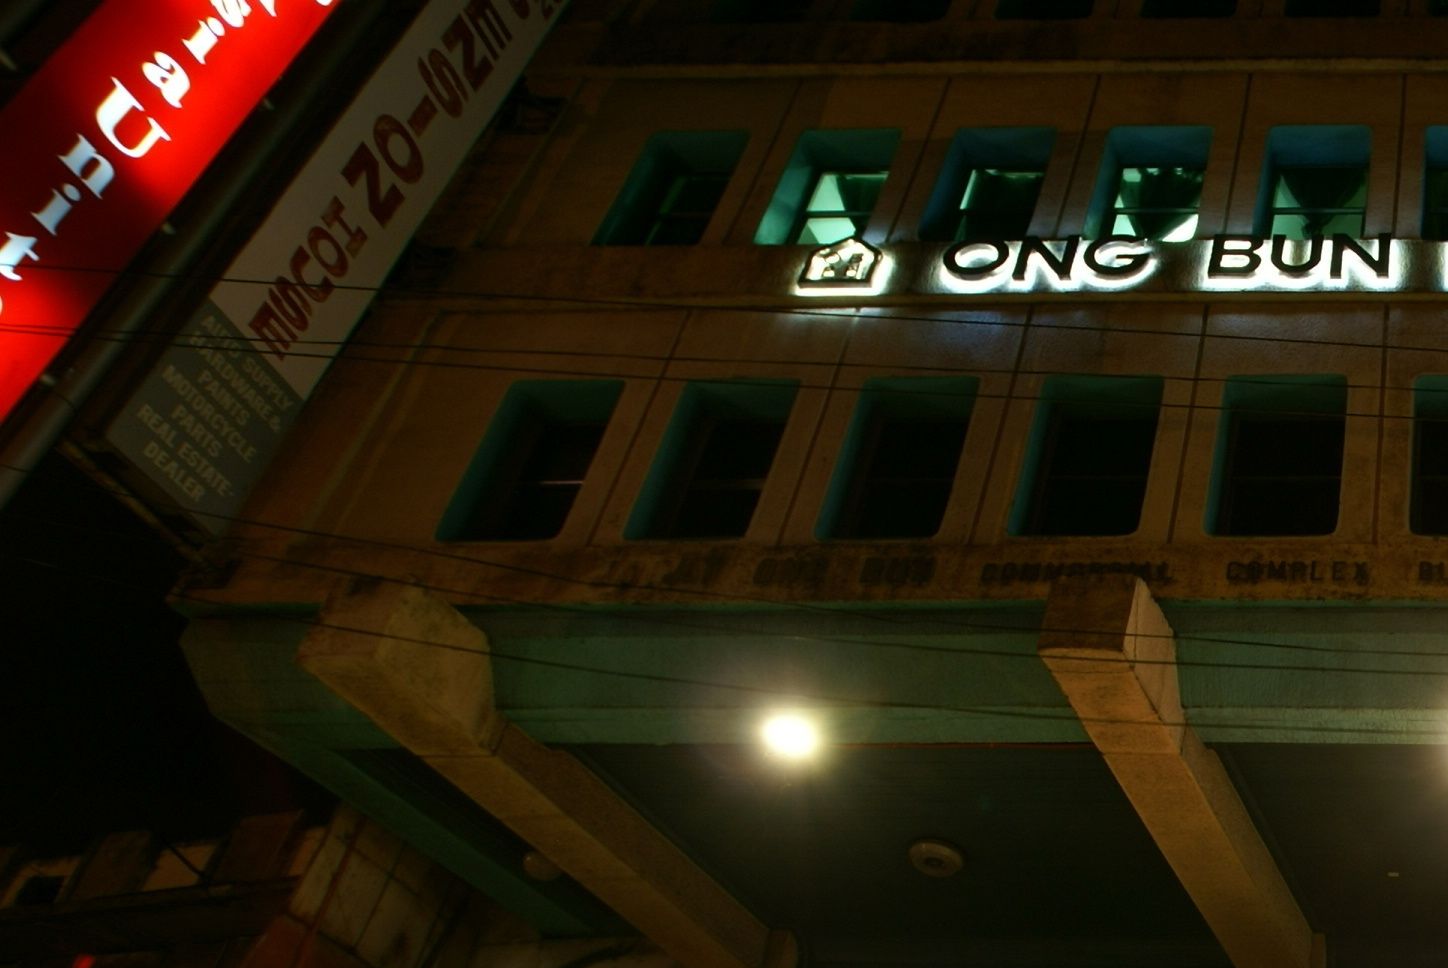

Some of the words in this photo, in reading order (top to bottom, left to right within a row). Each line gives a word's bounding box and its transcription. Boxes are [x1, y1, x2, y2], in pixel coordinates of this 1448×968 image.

[0, 76, 171, 314] Unit
[247, 200, 368, 362] HOUSE
[944, 234, 1150, 281] ONG
[1206, 232, 1392, 278] BUN
[196, 369, 252, 428] PAINTS
[239, 355, 295, 413] SUPPLY
[136, 402, 181, 450] REAL
[160, 362, 258, 466] MOTORCYCLE
[170, 403, 225, 460] PARTS
[142, 438, 207, 506] DEALER
[1226, 560, 1370, 586] COMPLEX
